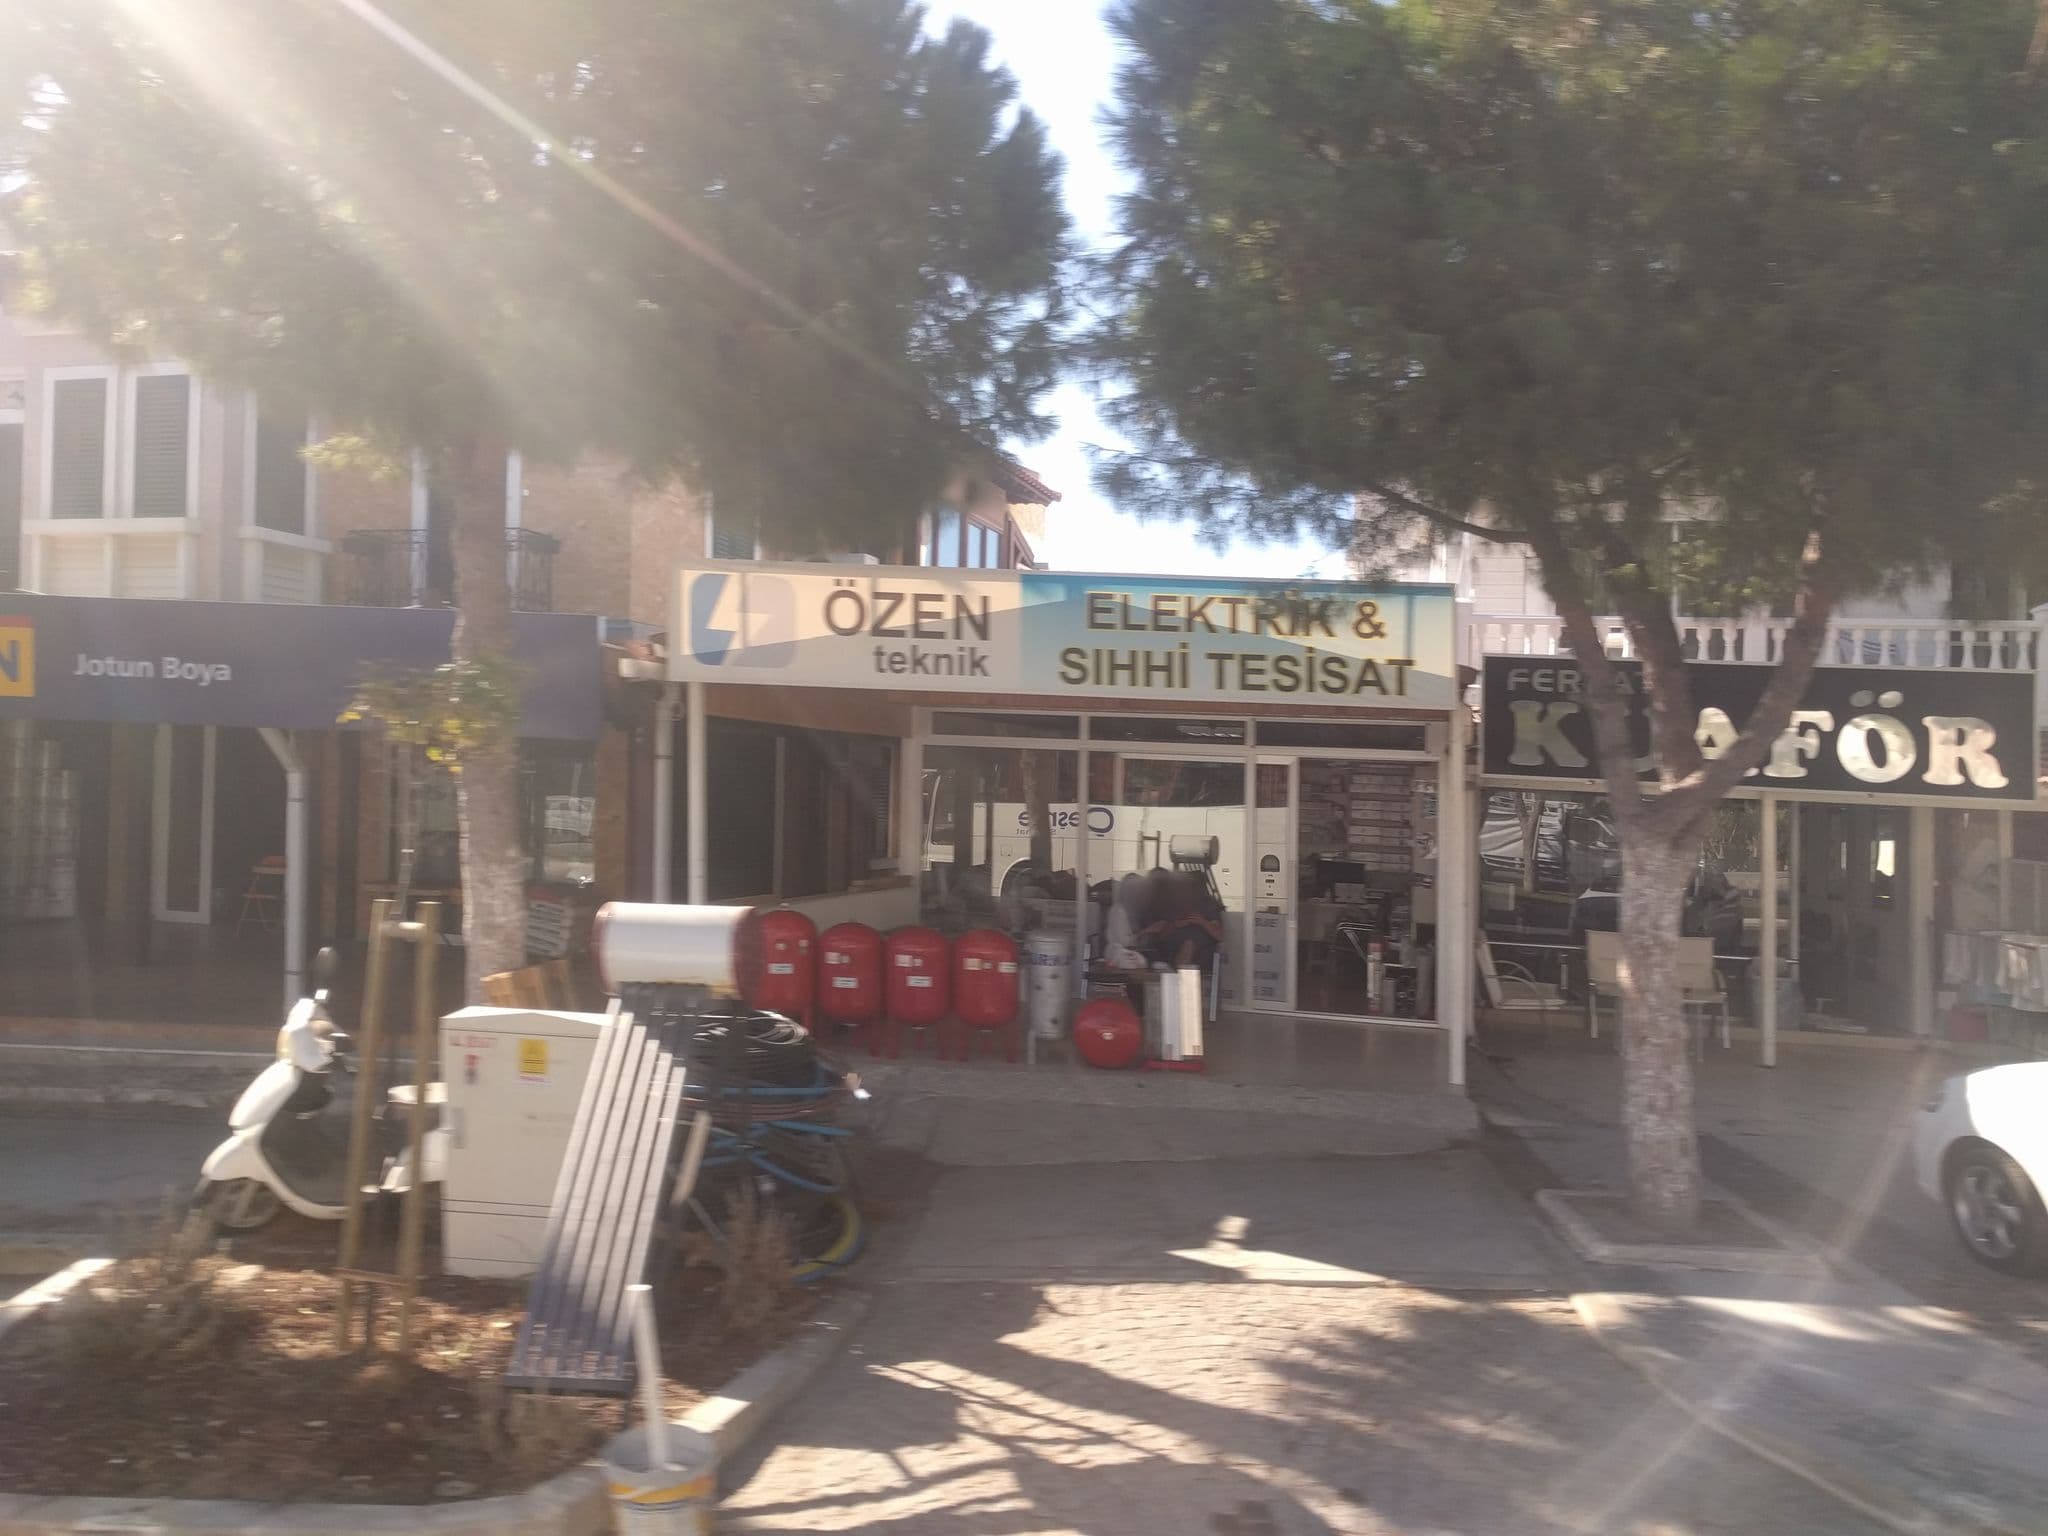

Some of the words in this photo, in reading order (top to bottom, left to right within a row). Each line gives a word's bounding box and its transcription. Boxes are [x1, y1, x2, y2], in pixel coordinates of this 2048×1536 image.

[824, 578, 991, 641] ÖZEN
[1085, 589, 1338, 638] ELEKTRİK
[1351, 599, 1388, 640] &
[74, 653, 154, 678] Jotun
[161, 656, 232, 686] Boya
[872, 645, 991, 677] teknik
[1058, 641, 1192, 689] SIHHİ
[1205, 645, 1415, 697] TESİSAT
